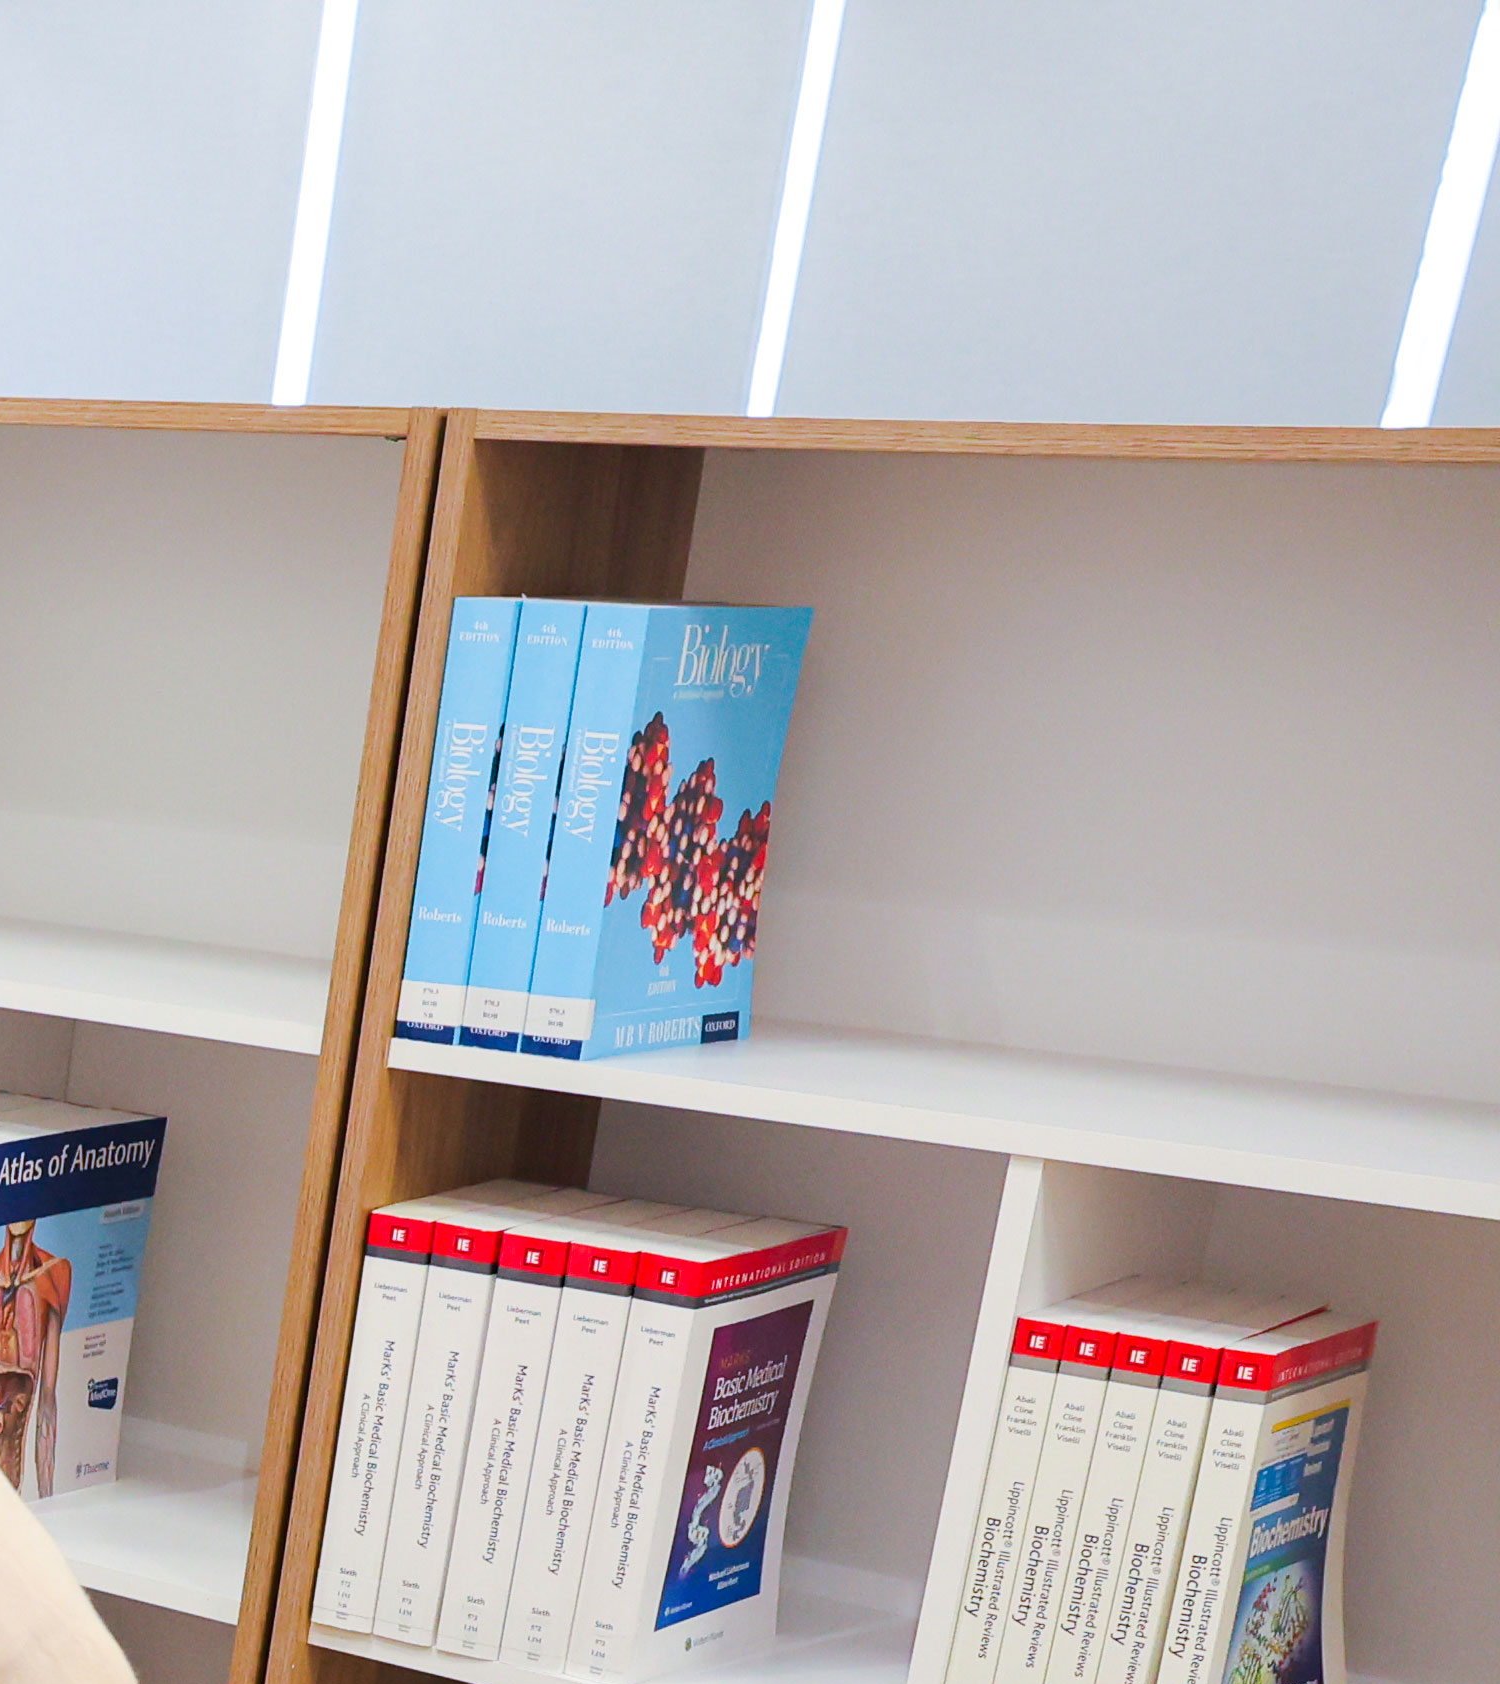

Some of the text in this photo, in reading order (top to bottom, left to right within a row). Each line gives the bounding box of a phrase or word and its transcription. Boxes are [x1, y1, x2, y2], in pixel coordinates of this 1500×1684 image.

[674, 624, 770, 697] Biology
[433, 719, 487, 833] Biology
[568, 729, 620, 843] Biology
[419, 907, 462, 924] Roberts
[546, 918, 591, 936] Roberts
[648, 1016, 701, 1045] ROBERTS
[704, 1018, 736, 1034] OXFORD
[47, 1148, 69, 1177] of
[71, 1137, 155, 1172] Anatomy
[393, 1229, 405, 1241] IE
[662, 1270, 675, 1285] IE
[1030, 1335, 1044, 1348] IE
[714, 1355, 788, 1401] Basic Medical
[1237, 1366, 1253, 1380] IE
[357, 1402, 370, 1432] Clinical
[376, 1383, 389, 1415] Basic
[708, 1390, 779, 1430] Biochemistry
[352, 1434, 364, 1478] Approach
[367, 1417, 384, 1460] Medical
[354, 1462, 377, 1536] Biochemistry
[1250, 1506, 1329, 1558] Biochemistry
[965, 1517, 1000, 1617] Biochemistry
[989, 1551, 1011, 1611] Illustrated
[978, 1613, 997, 1659] Reviews
